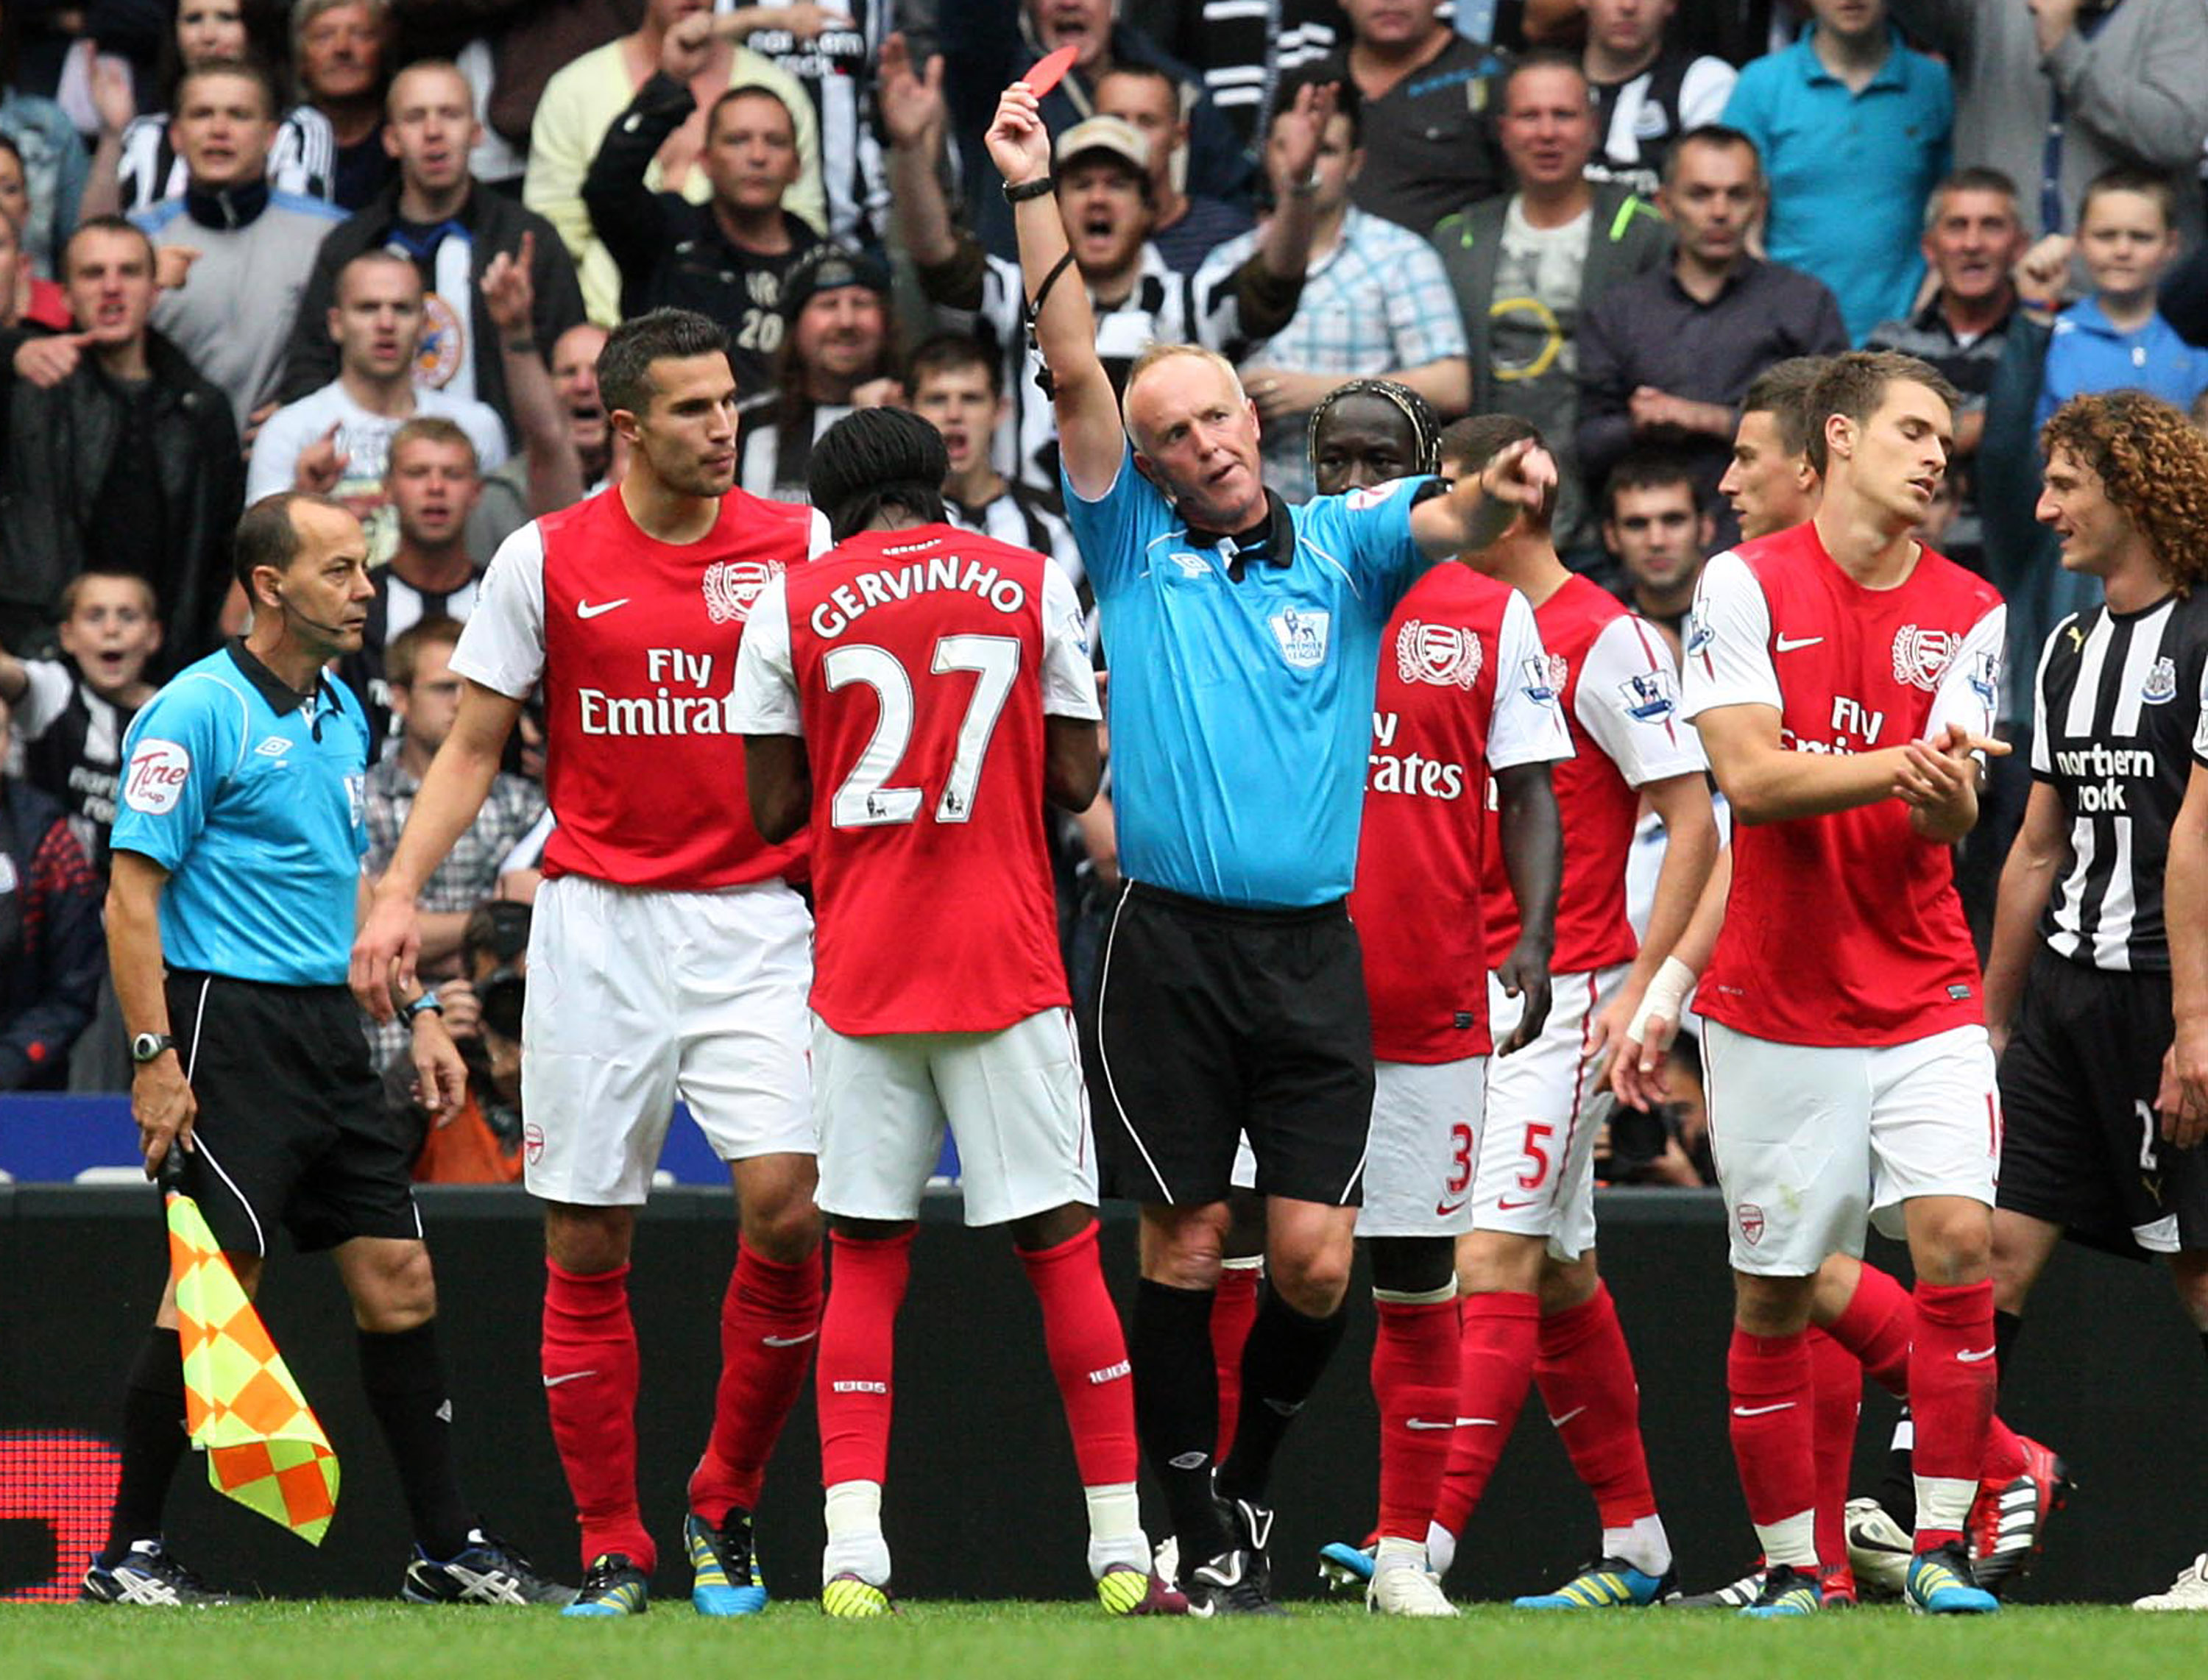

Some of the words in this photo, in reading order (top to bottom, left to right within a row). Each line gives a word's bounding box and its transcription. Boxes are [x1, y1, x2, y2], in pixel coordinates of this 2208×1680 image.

[747, 29, 865, 57] norern
[737, 308, 784, 353] 20
[810, 555, 1025, 639] GERVINHO
[647, 648, 712, 688] Fly
[578, 687, 736, 735] Emirat
[823, 634, 1022, 828] 27
[1831, 695, 1883, 745] Fly
[2056, 742, 2155, 778] northern
[2078, 777, 2127, 812] rock
[1447, 1121, 1473, 1195] 3
[1516, 1121, 1554, 1192] 5
[2134, 1098, 2158, 1172] 2
